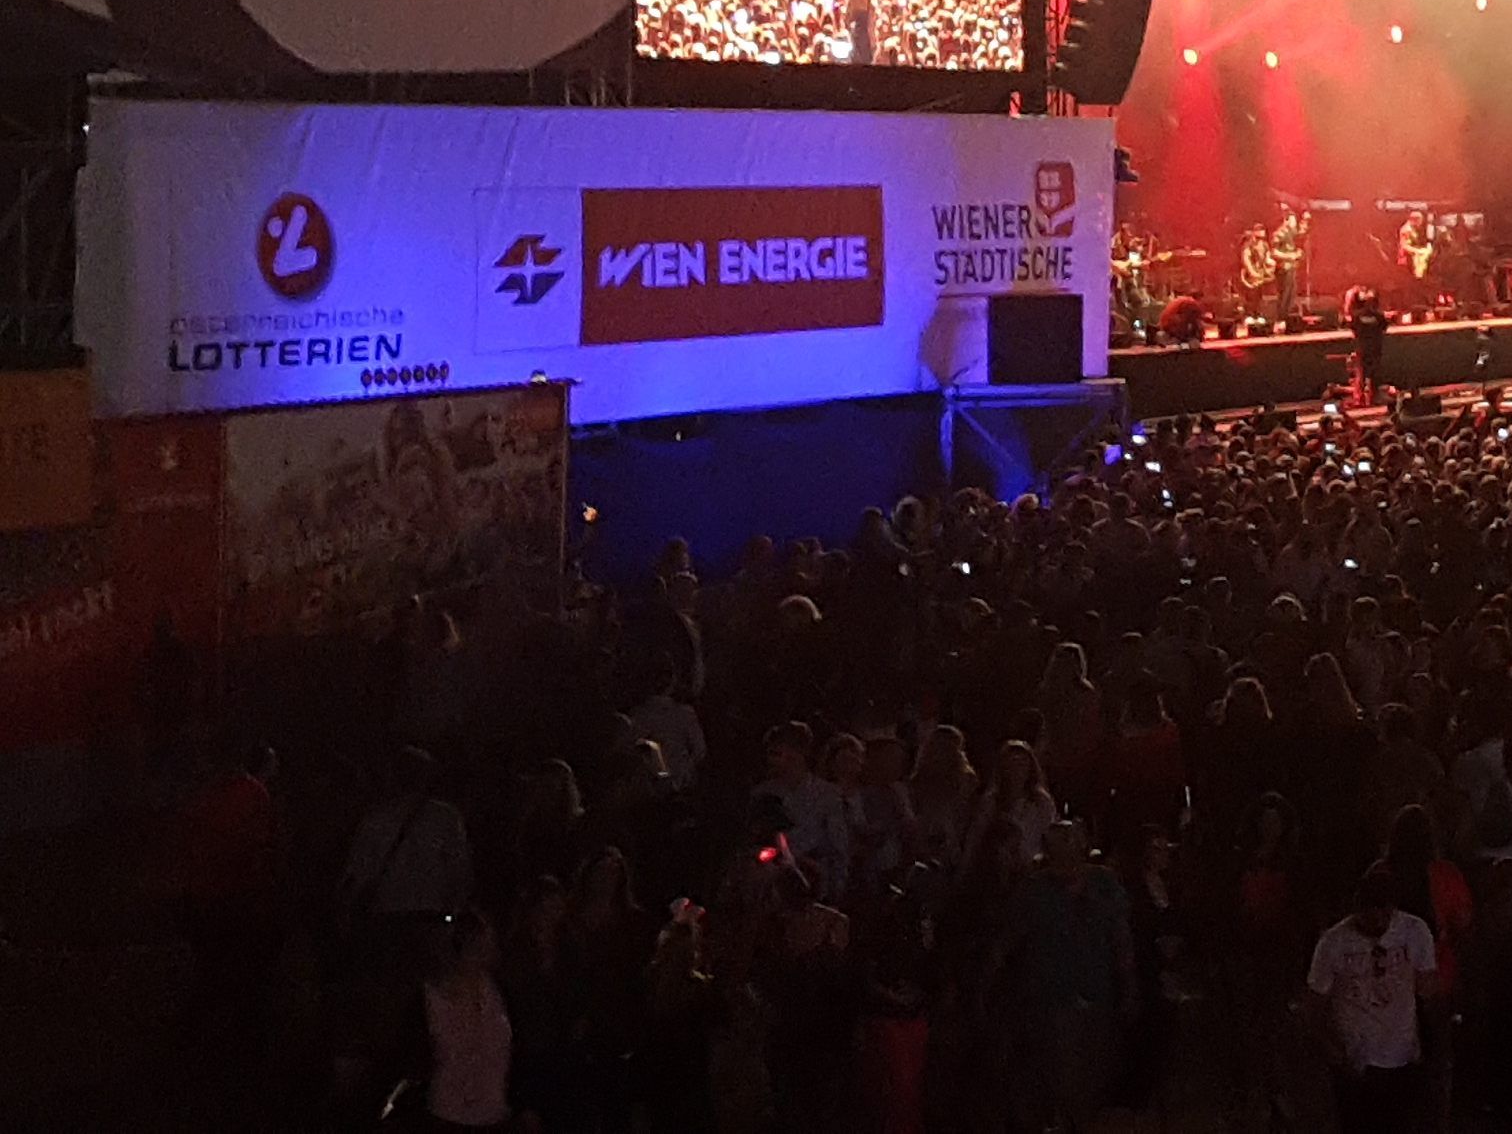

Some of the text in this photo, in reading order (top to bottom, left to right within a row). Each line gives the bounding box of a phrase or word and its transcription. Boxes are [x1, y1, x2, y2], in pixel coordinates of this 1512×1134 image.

[932, 203, 1033, 241] WIENER
[597, 235, 869, 288] WIEN ENERGIE
[934, 246, 1073, 285] STÄDTISCHE
[168, 333, 403, 372] LOTTERIEN
